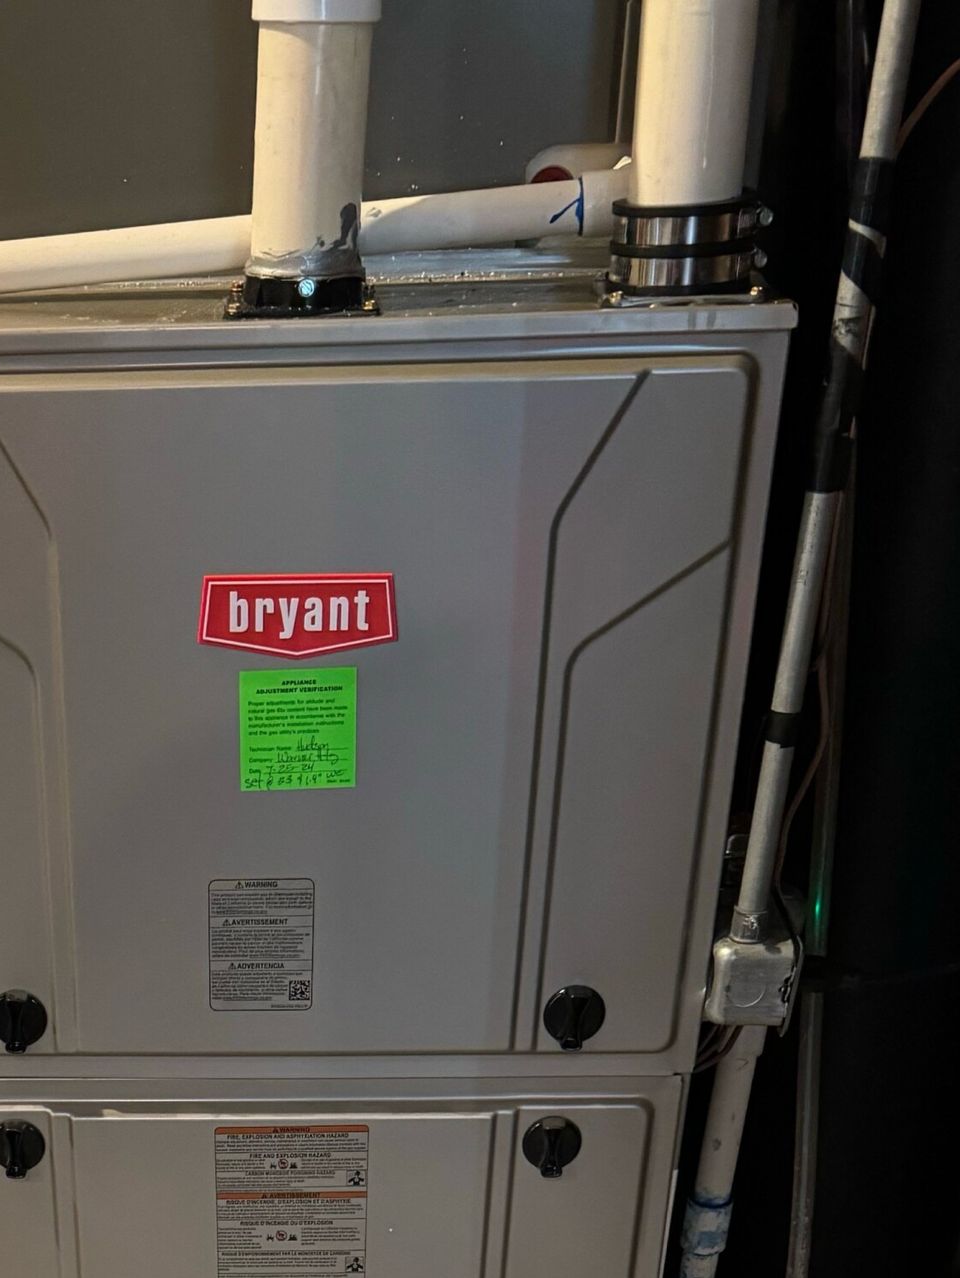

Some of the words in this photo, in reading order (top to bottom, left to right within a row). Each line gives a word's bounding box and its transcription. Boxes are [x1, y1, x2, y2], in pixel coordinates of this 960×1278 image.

[229, 590, 370, 640] bryant
[245, 881, 278, 889] WARNING
[232, 918, 288, 926] AVERTISSEMENT
